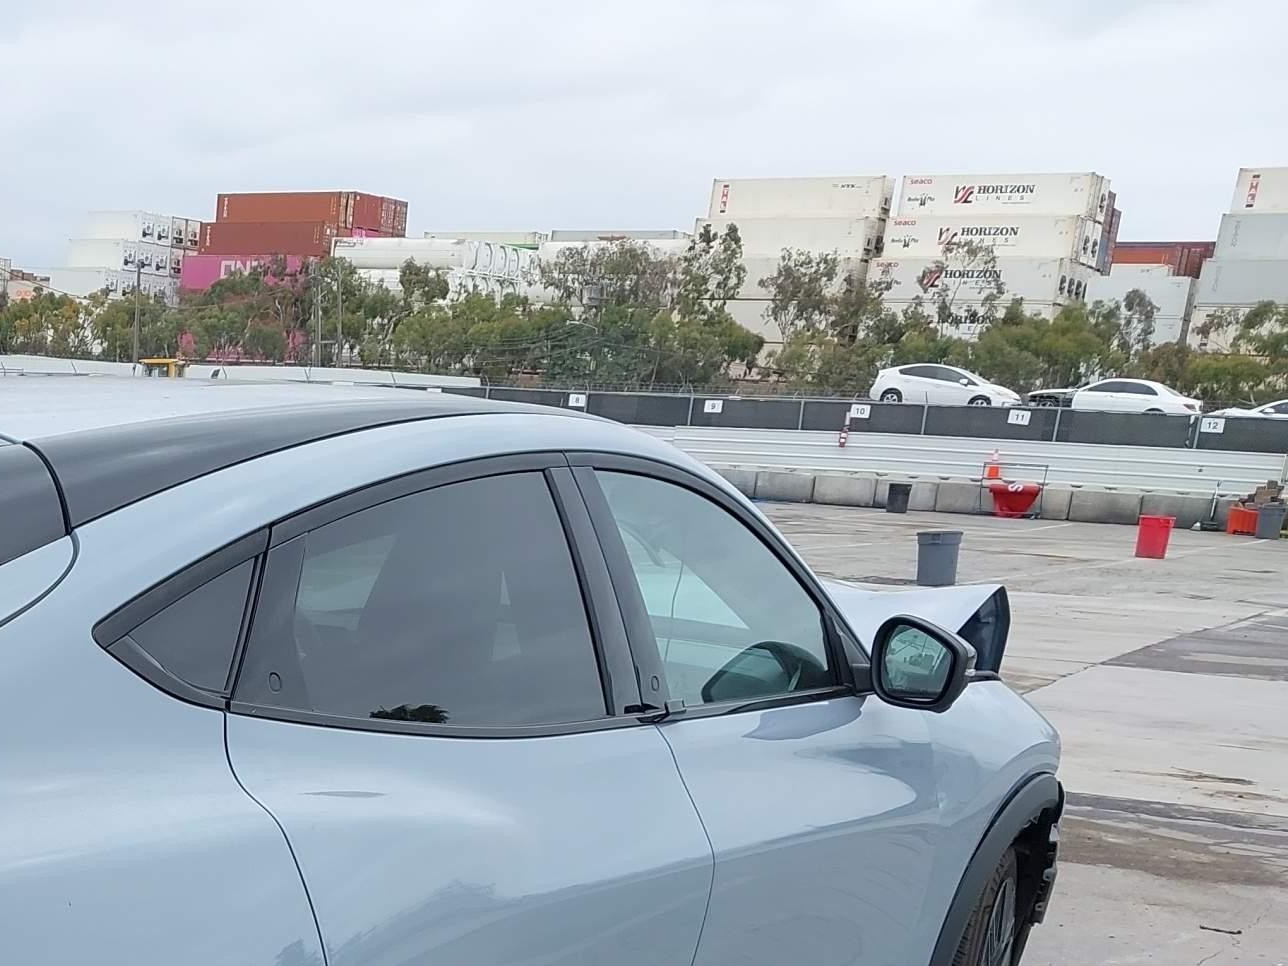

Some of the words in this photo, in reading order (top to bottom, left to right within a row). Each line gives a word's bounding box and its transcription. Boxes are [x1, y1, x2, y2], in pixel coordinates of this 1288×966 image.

[977, 184, 1035, 194] HORIZON
[961, 227, 1019, 237] HORIZON
[944, 269, 1002, 279] HORIZON
[856, 407, 866, 415] 10
[1015, 413, 1025, 421] 11
[1207, 421, 1219, 430] 12
